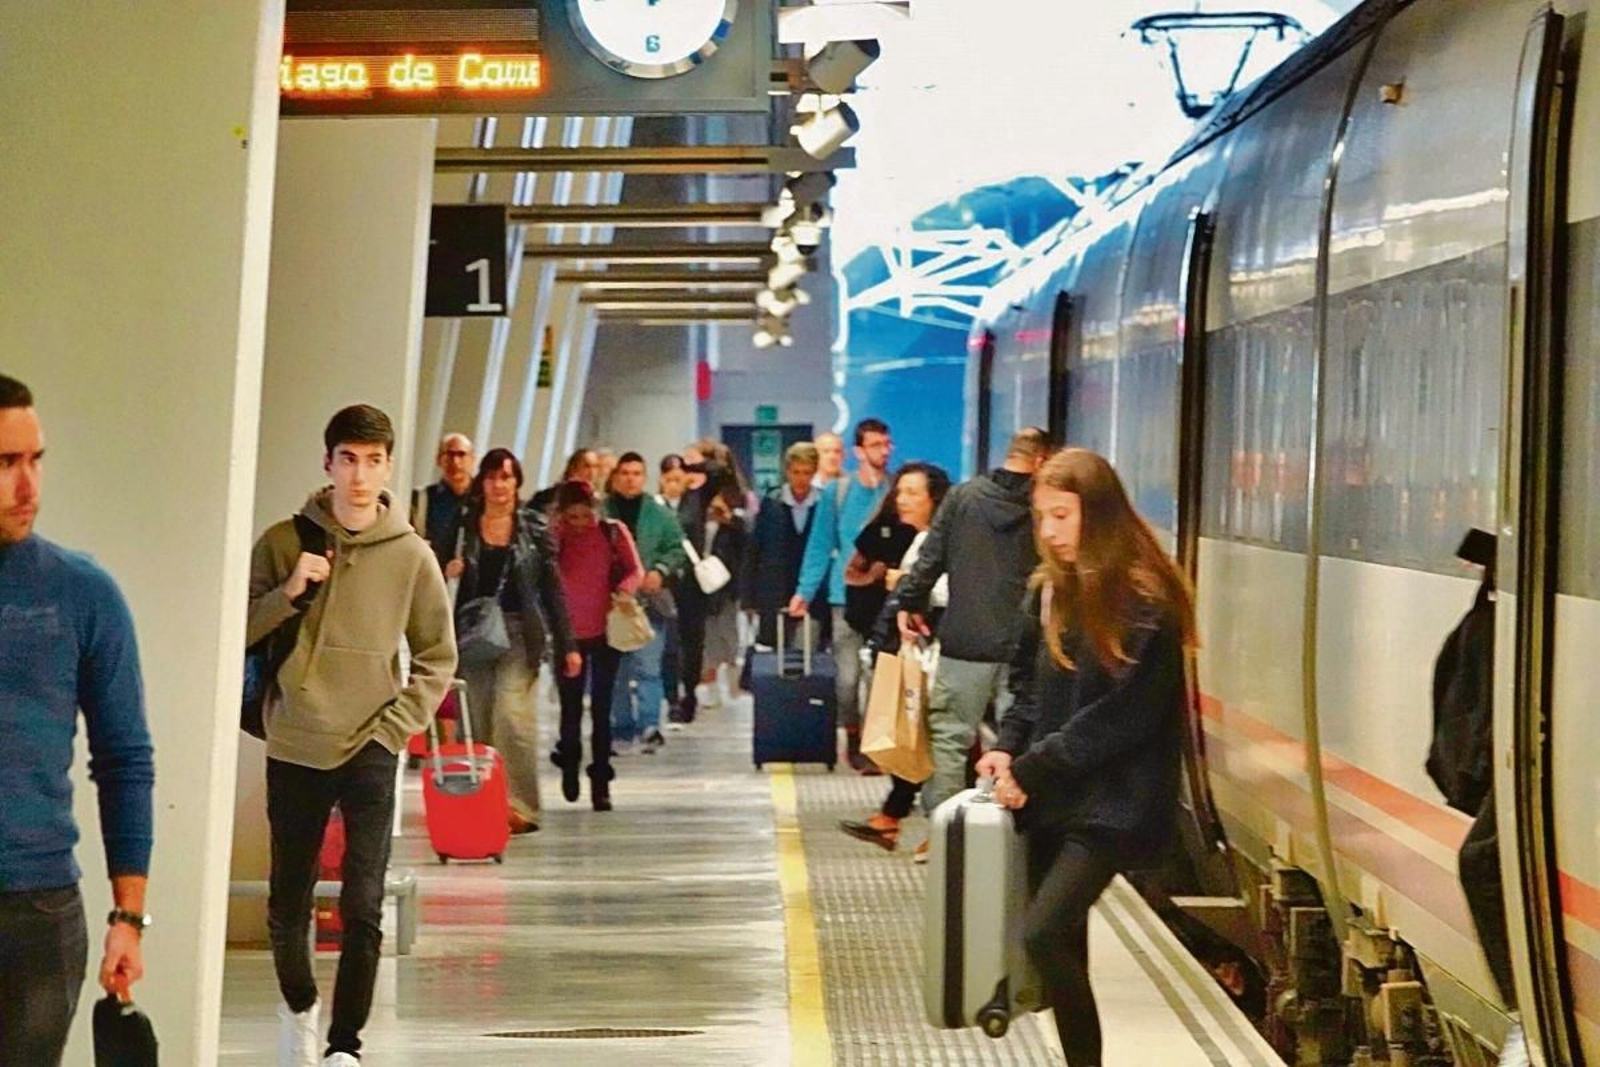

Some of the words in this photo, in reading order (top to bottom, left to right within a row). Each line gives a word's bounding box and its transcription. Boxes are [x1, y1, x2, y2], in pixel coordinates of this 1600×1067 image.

[644, 34, 661, 53] 6
[388, 53, 436, 90] de
[465, 258, 503, 312] 1
